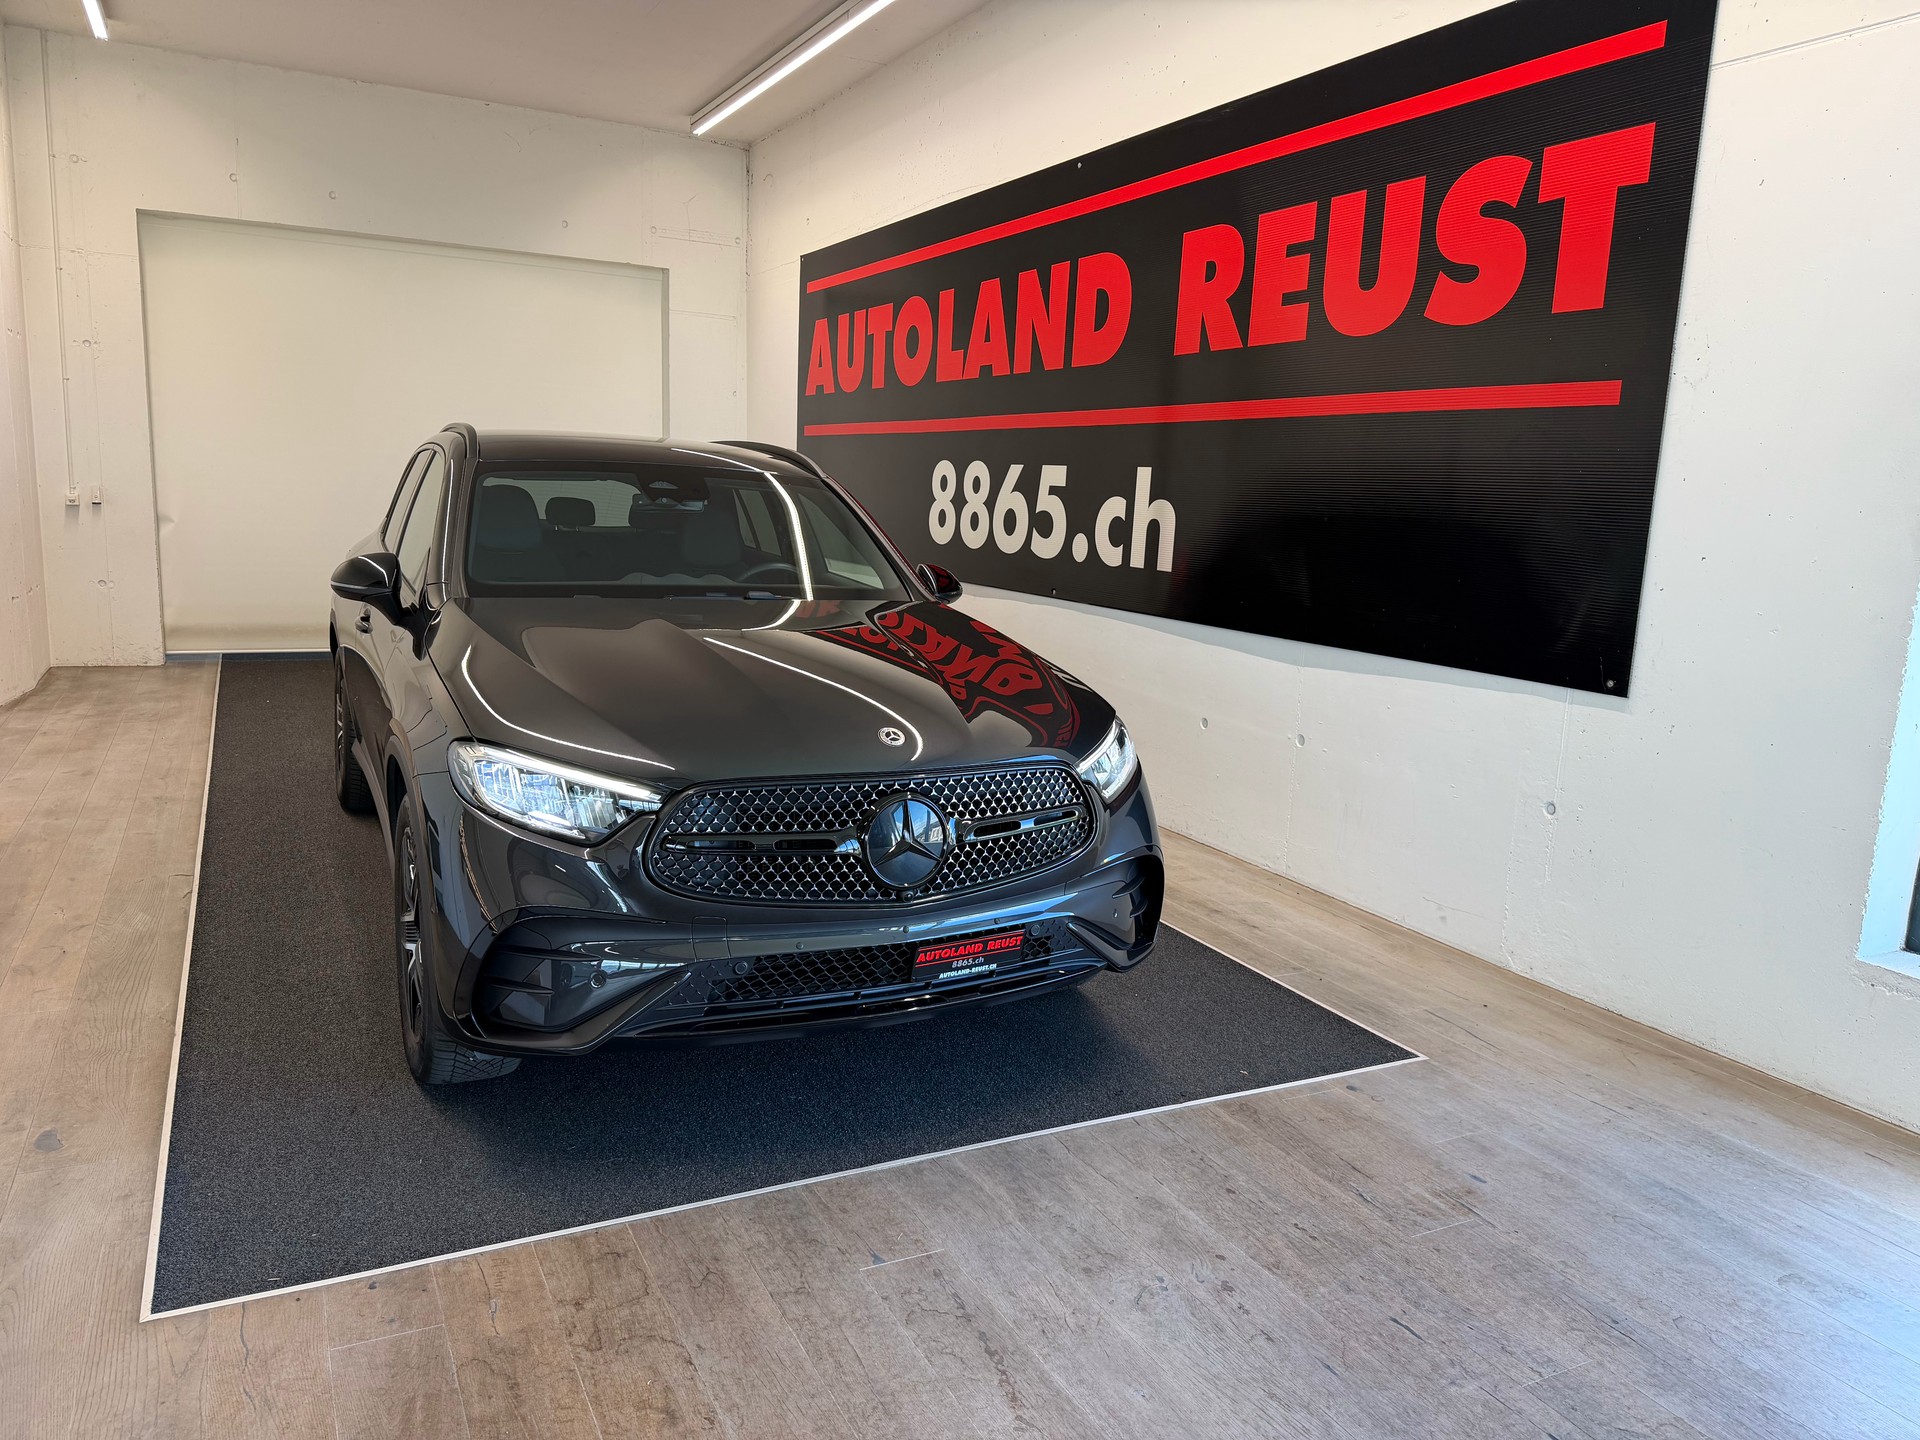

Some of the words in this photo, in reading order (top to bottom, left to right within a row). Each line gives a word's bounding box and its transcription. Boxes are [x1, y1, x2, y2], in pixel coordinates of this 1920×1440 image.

[805, 252, 1133, 397] AUTOLAND
[1173, 122, 1657, 356] REUST
[928, 460, 1176, 573] 8865.ch
[917, 944, 983, 962] AUTOLAND
[988, 936, 1023, 950] REUST
[939, 964, 997, 978] AUTOLAND-REUST.CH
[952, 957, 984, 968] 8865.ch
